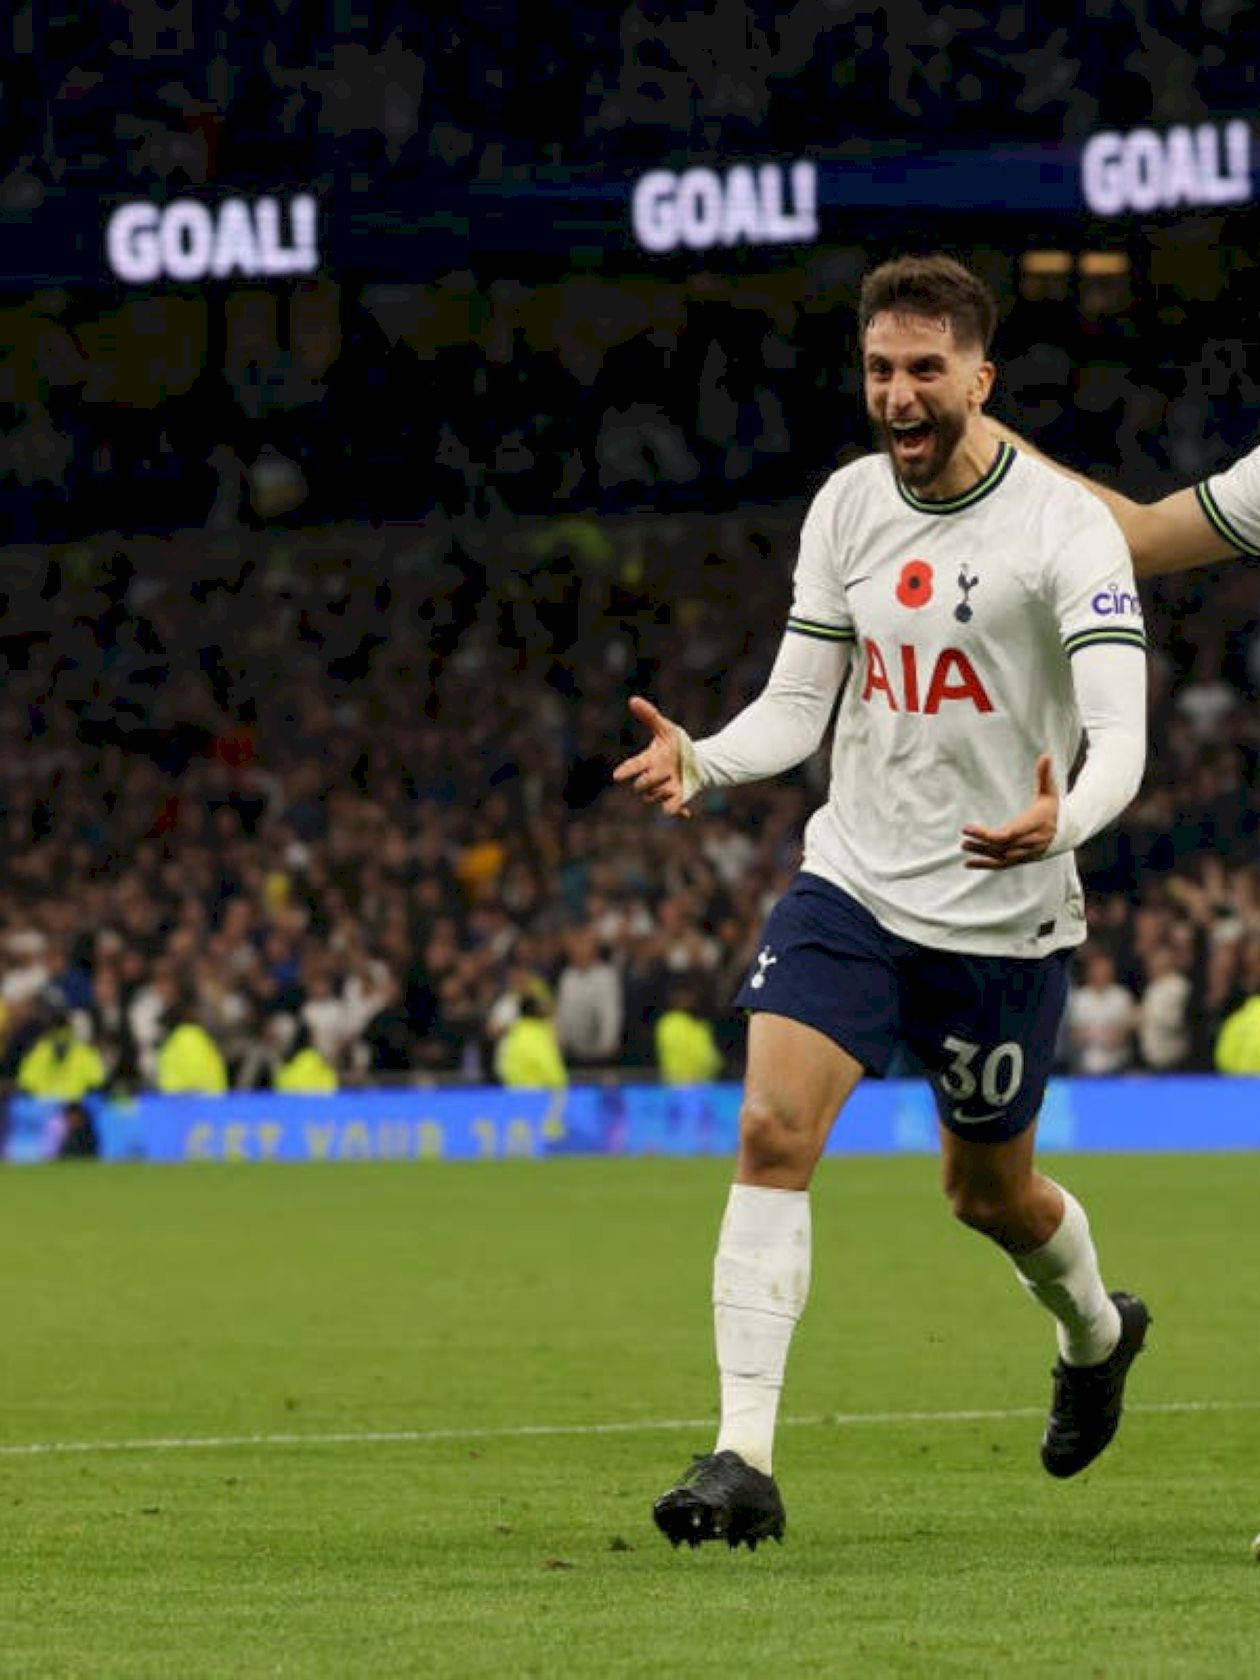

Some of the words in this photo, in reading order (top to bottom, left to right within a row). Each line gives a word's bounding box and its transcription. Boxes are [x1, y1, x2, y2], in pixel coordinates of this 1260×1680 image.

[633, 162, 818, 251] GOAL!
[1081, 121, 1251, 214] GOAL!
[107, 195, 318, 282] GOAL!
[1091, 584, 1140, 616] cin
[862, 637, 994, 714] AIA
[941, 1034, 1024, 1106] 30
